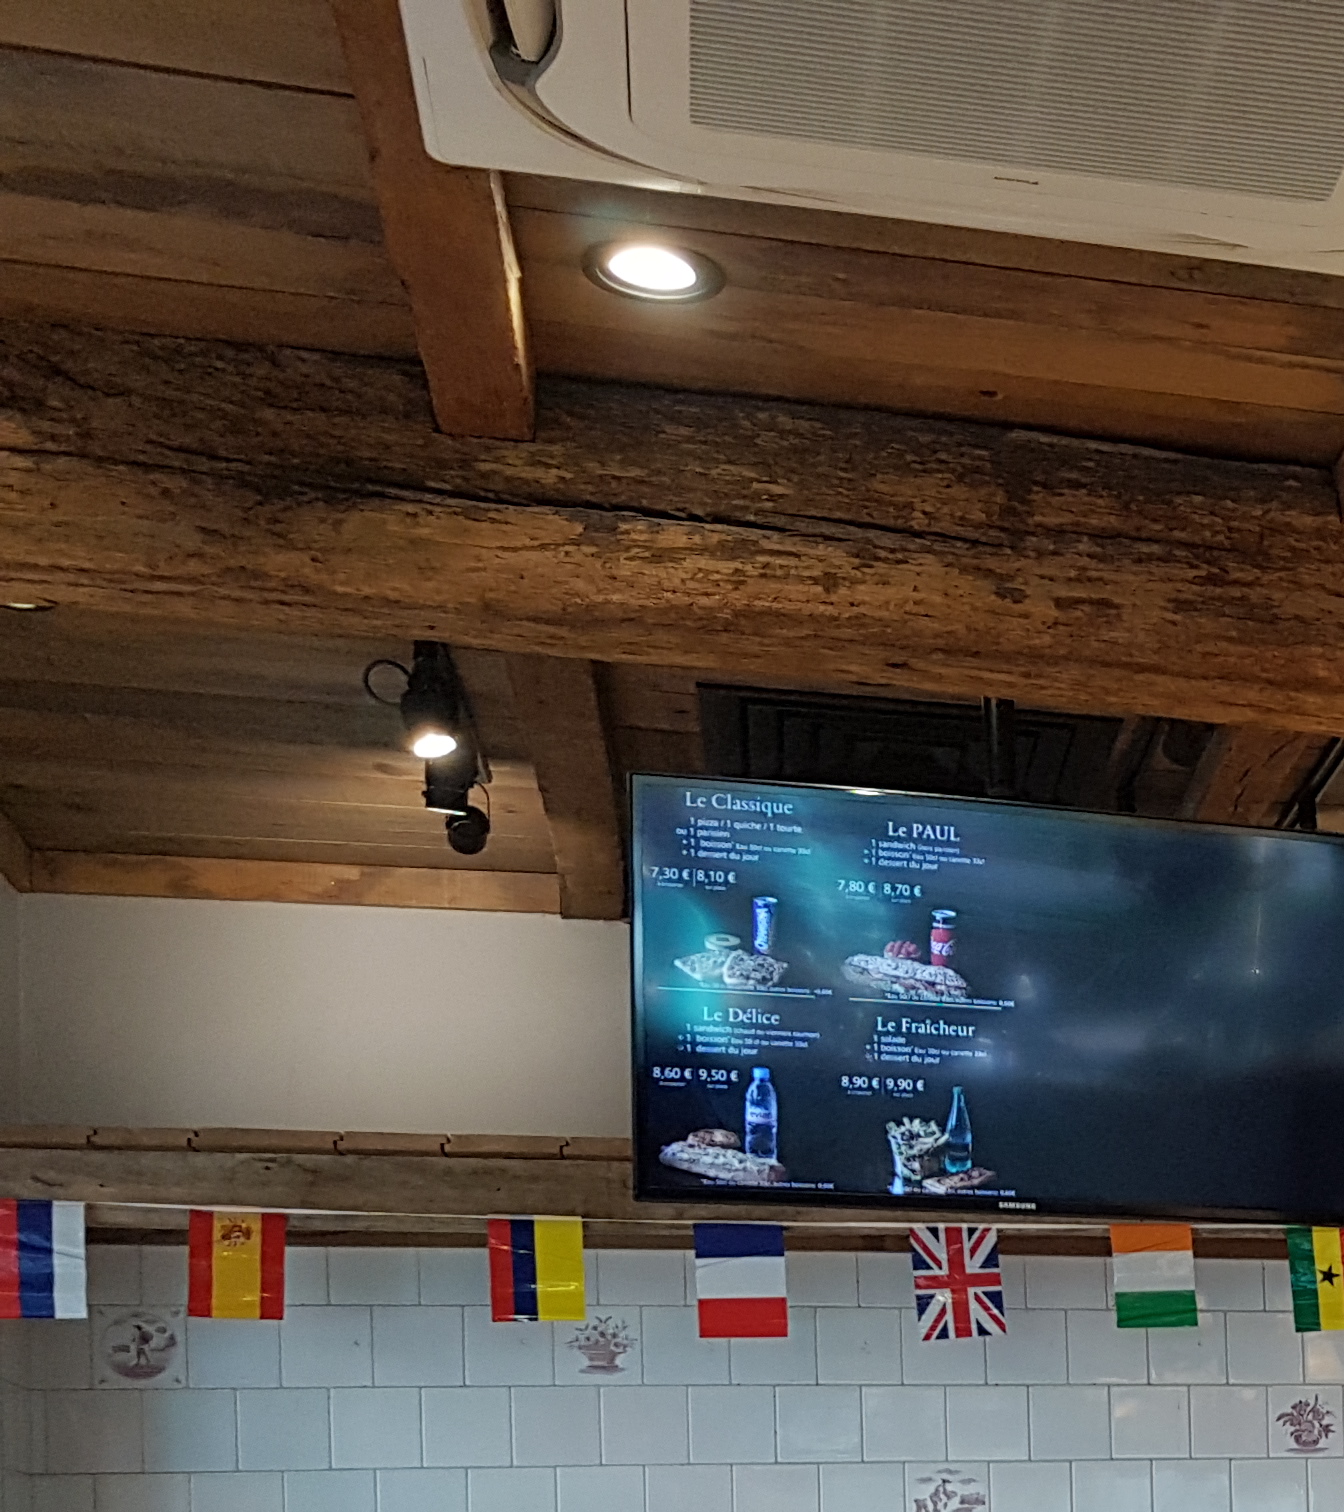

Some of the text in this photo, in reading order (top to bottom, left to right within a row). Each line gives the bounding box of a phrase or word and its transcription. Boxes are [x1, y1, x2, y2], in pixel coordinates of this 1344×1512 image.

[685, 792, 793, 818] Le Classique
[734, 822, 762, 831] quiche
[888, 821, 961, 842] Le PAUL
[878, 840, 916, 851] sandwich
[730, 852, 741, 860] du
[650, 866, 690, 880] 7,30 €
[696, 869, 736, 884] 8,10 €
[837, 880, 876, 894] 7,80 €
[883, 883, 922, 897] 8,70 €
[704, 1006, 781, 1025] Le Délice
[877, 1016, 976, 1037] Le Fraîcheur
[728, 1046, 739, 1055] du
[653, 1066, 693, 1080] 8,60 €
[698, 1069, 739, 1082] 9,50 €
[842, 1076, 880, 1089] 8,90 €
[886, 1079, 925, 1091] 9,90 €
[998, 1202, 1036, 1210] SAMSUNG
